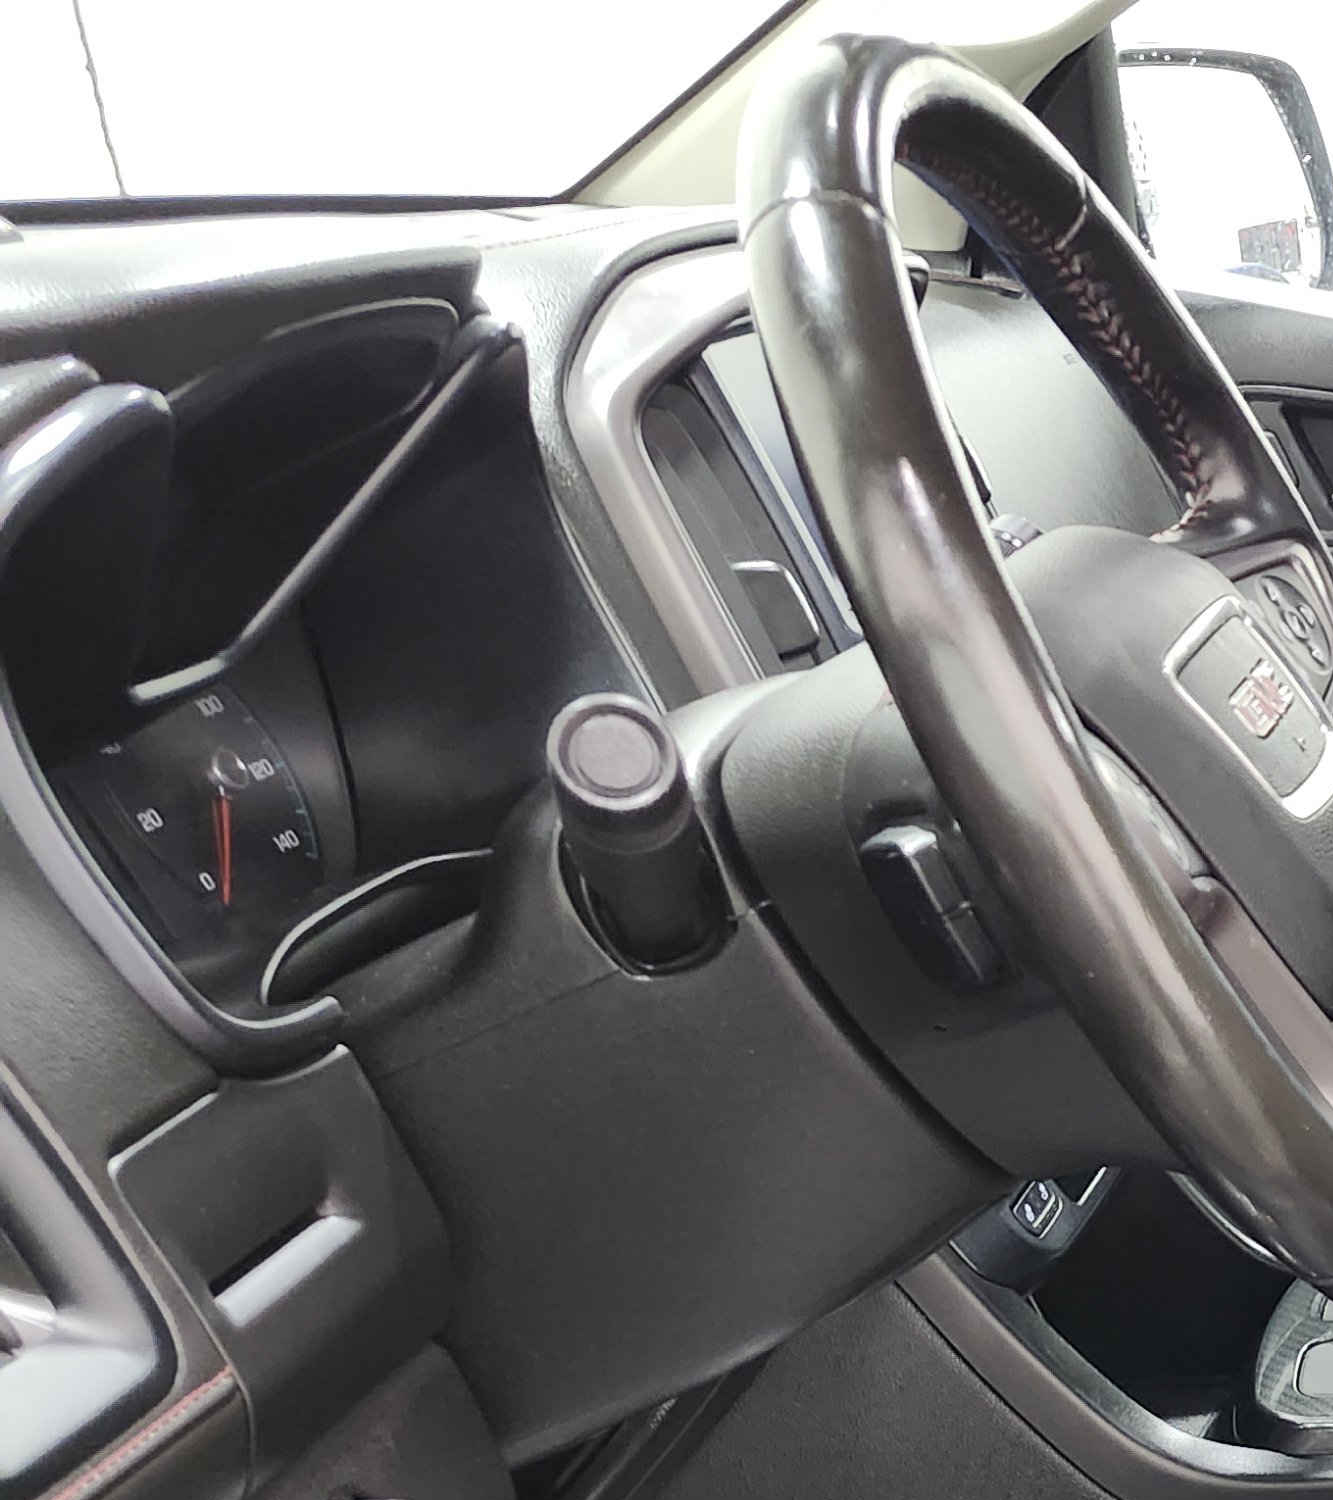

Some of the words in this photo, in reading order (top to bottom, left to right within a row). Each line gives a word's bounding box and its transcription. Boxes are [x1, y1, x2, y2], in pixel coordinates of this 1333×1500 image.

[196, 695, 225, 718] 100
[248, 758, 276, 782] 120
[136, 807, 164, 833] 20
[272, 829, 301, 853] 140
[198, 870, 217, 892] 0
